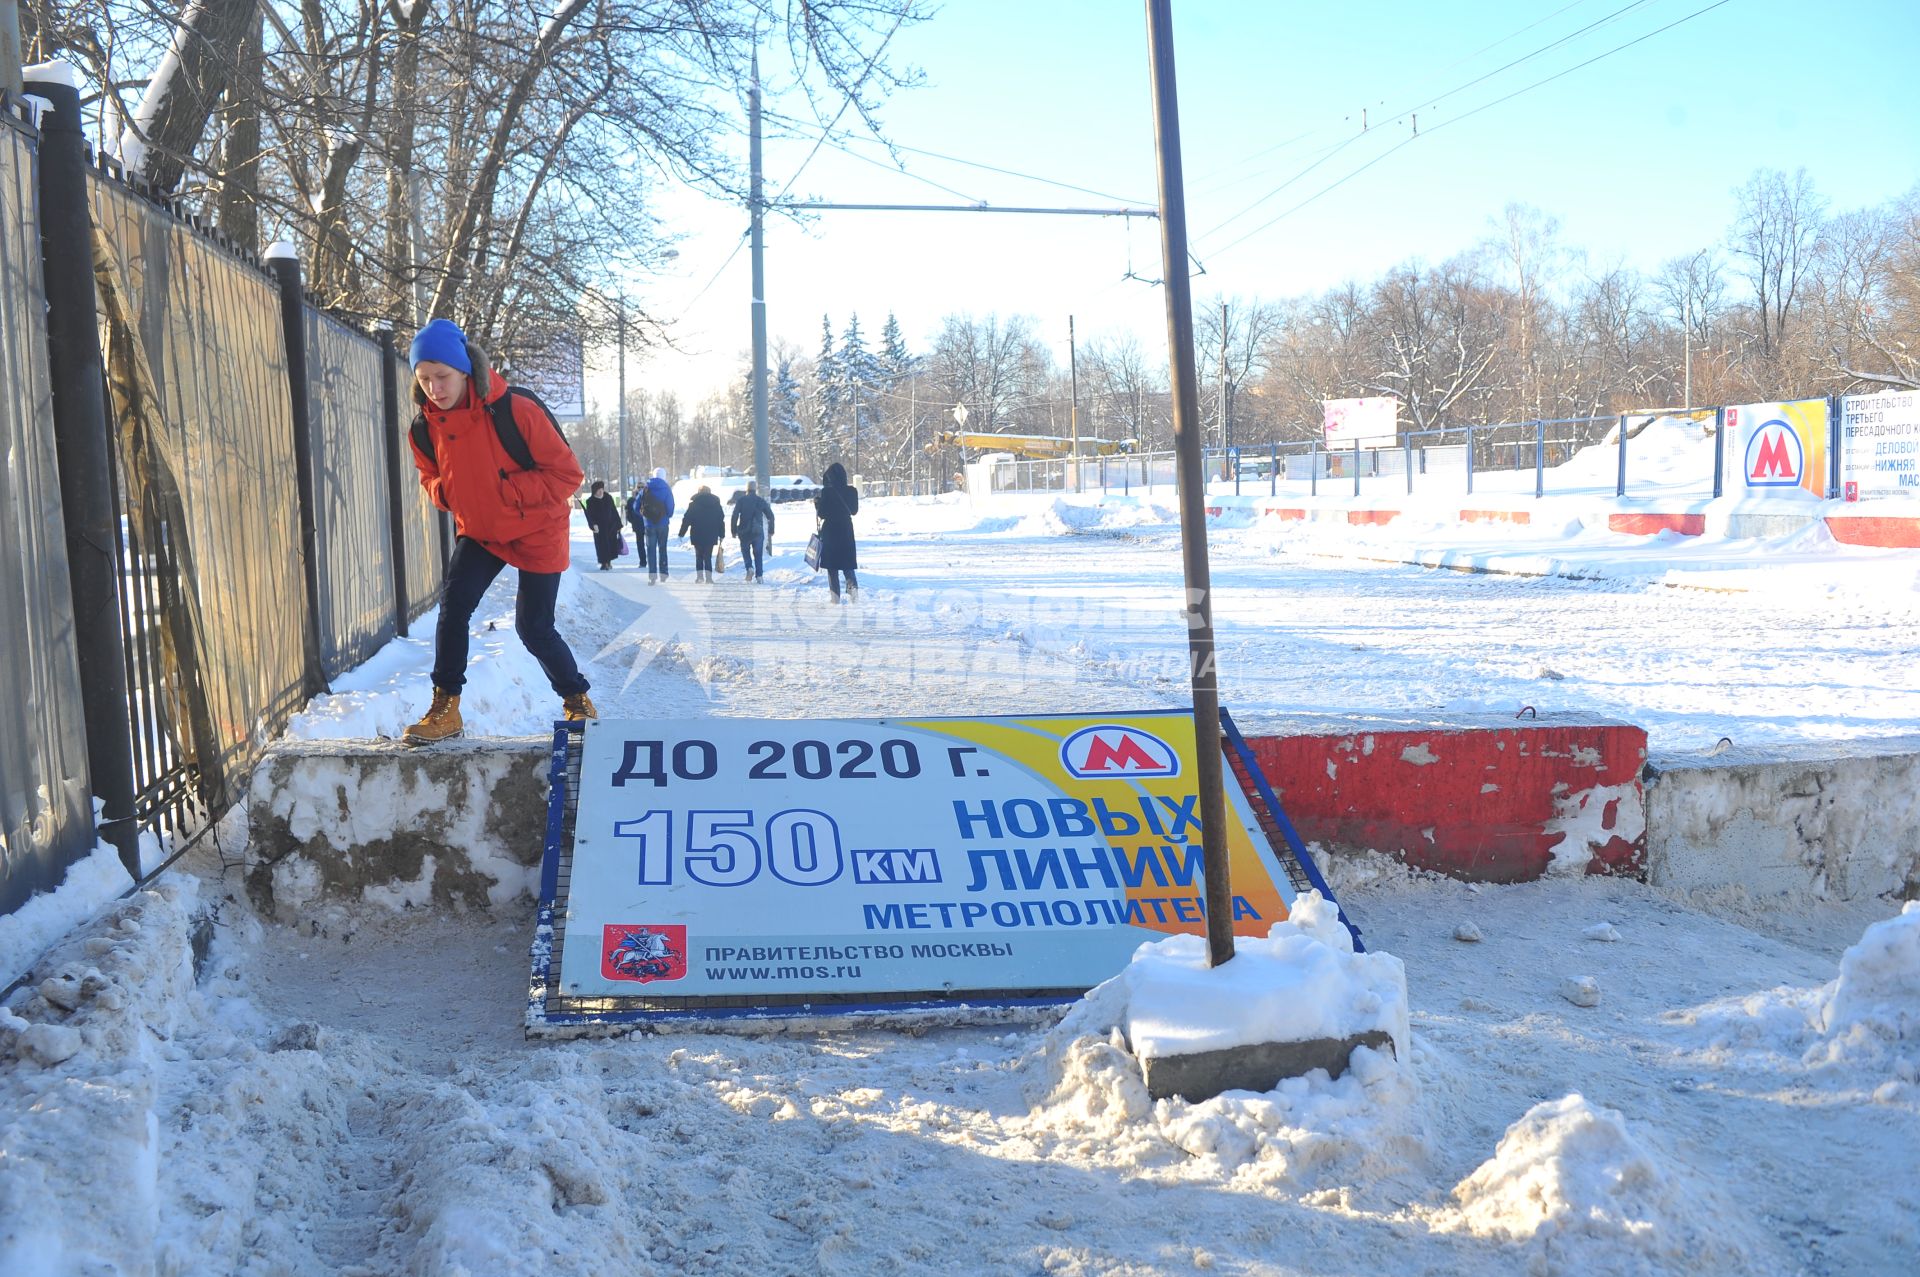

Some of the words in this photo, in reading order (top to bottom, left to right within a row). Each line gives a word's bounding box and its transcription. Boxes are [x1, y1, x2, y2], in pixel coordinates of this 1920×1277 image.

[1845, 396, 1913, 411] СТРОИТЕЛЬСТВО
[1845, 411, 1884, 424] ТРЕТЬЕГО
[1845, 424, 1911, 438] ПЕРЕСАДОЧНОГО
[1875, 458, 1916, 472] НИЖНЯЯ
[611, 740, 718, 787] ДО
[747, 738, 922, 780] 2020
[952, 795, 1202, 839] НОВЫХ
[613, 808, 844, 887] 150
[966, 834, 1205, 892] ЛИНИЙ
[863, 895, 1263, 930] МЕТРОПОЛИТЕА
[705, 944, 904, 962] ПРАВИТЕЛЬСТВО
[911, 943, 1013, 958] МОСКВЫ
[705, 964, 862, 980] www.mos.ru
